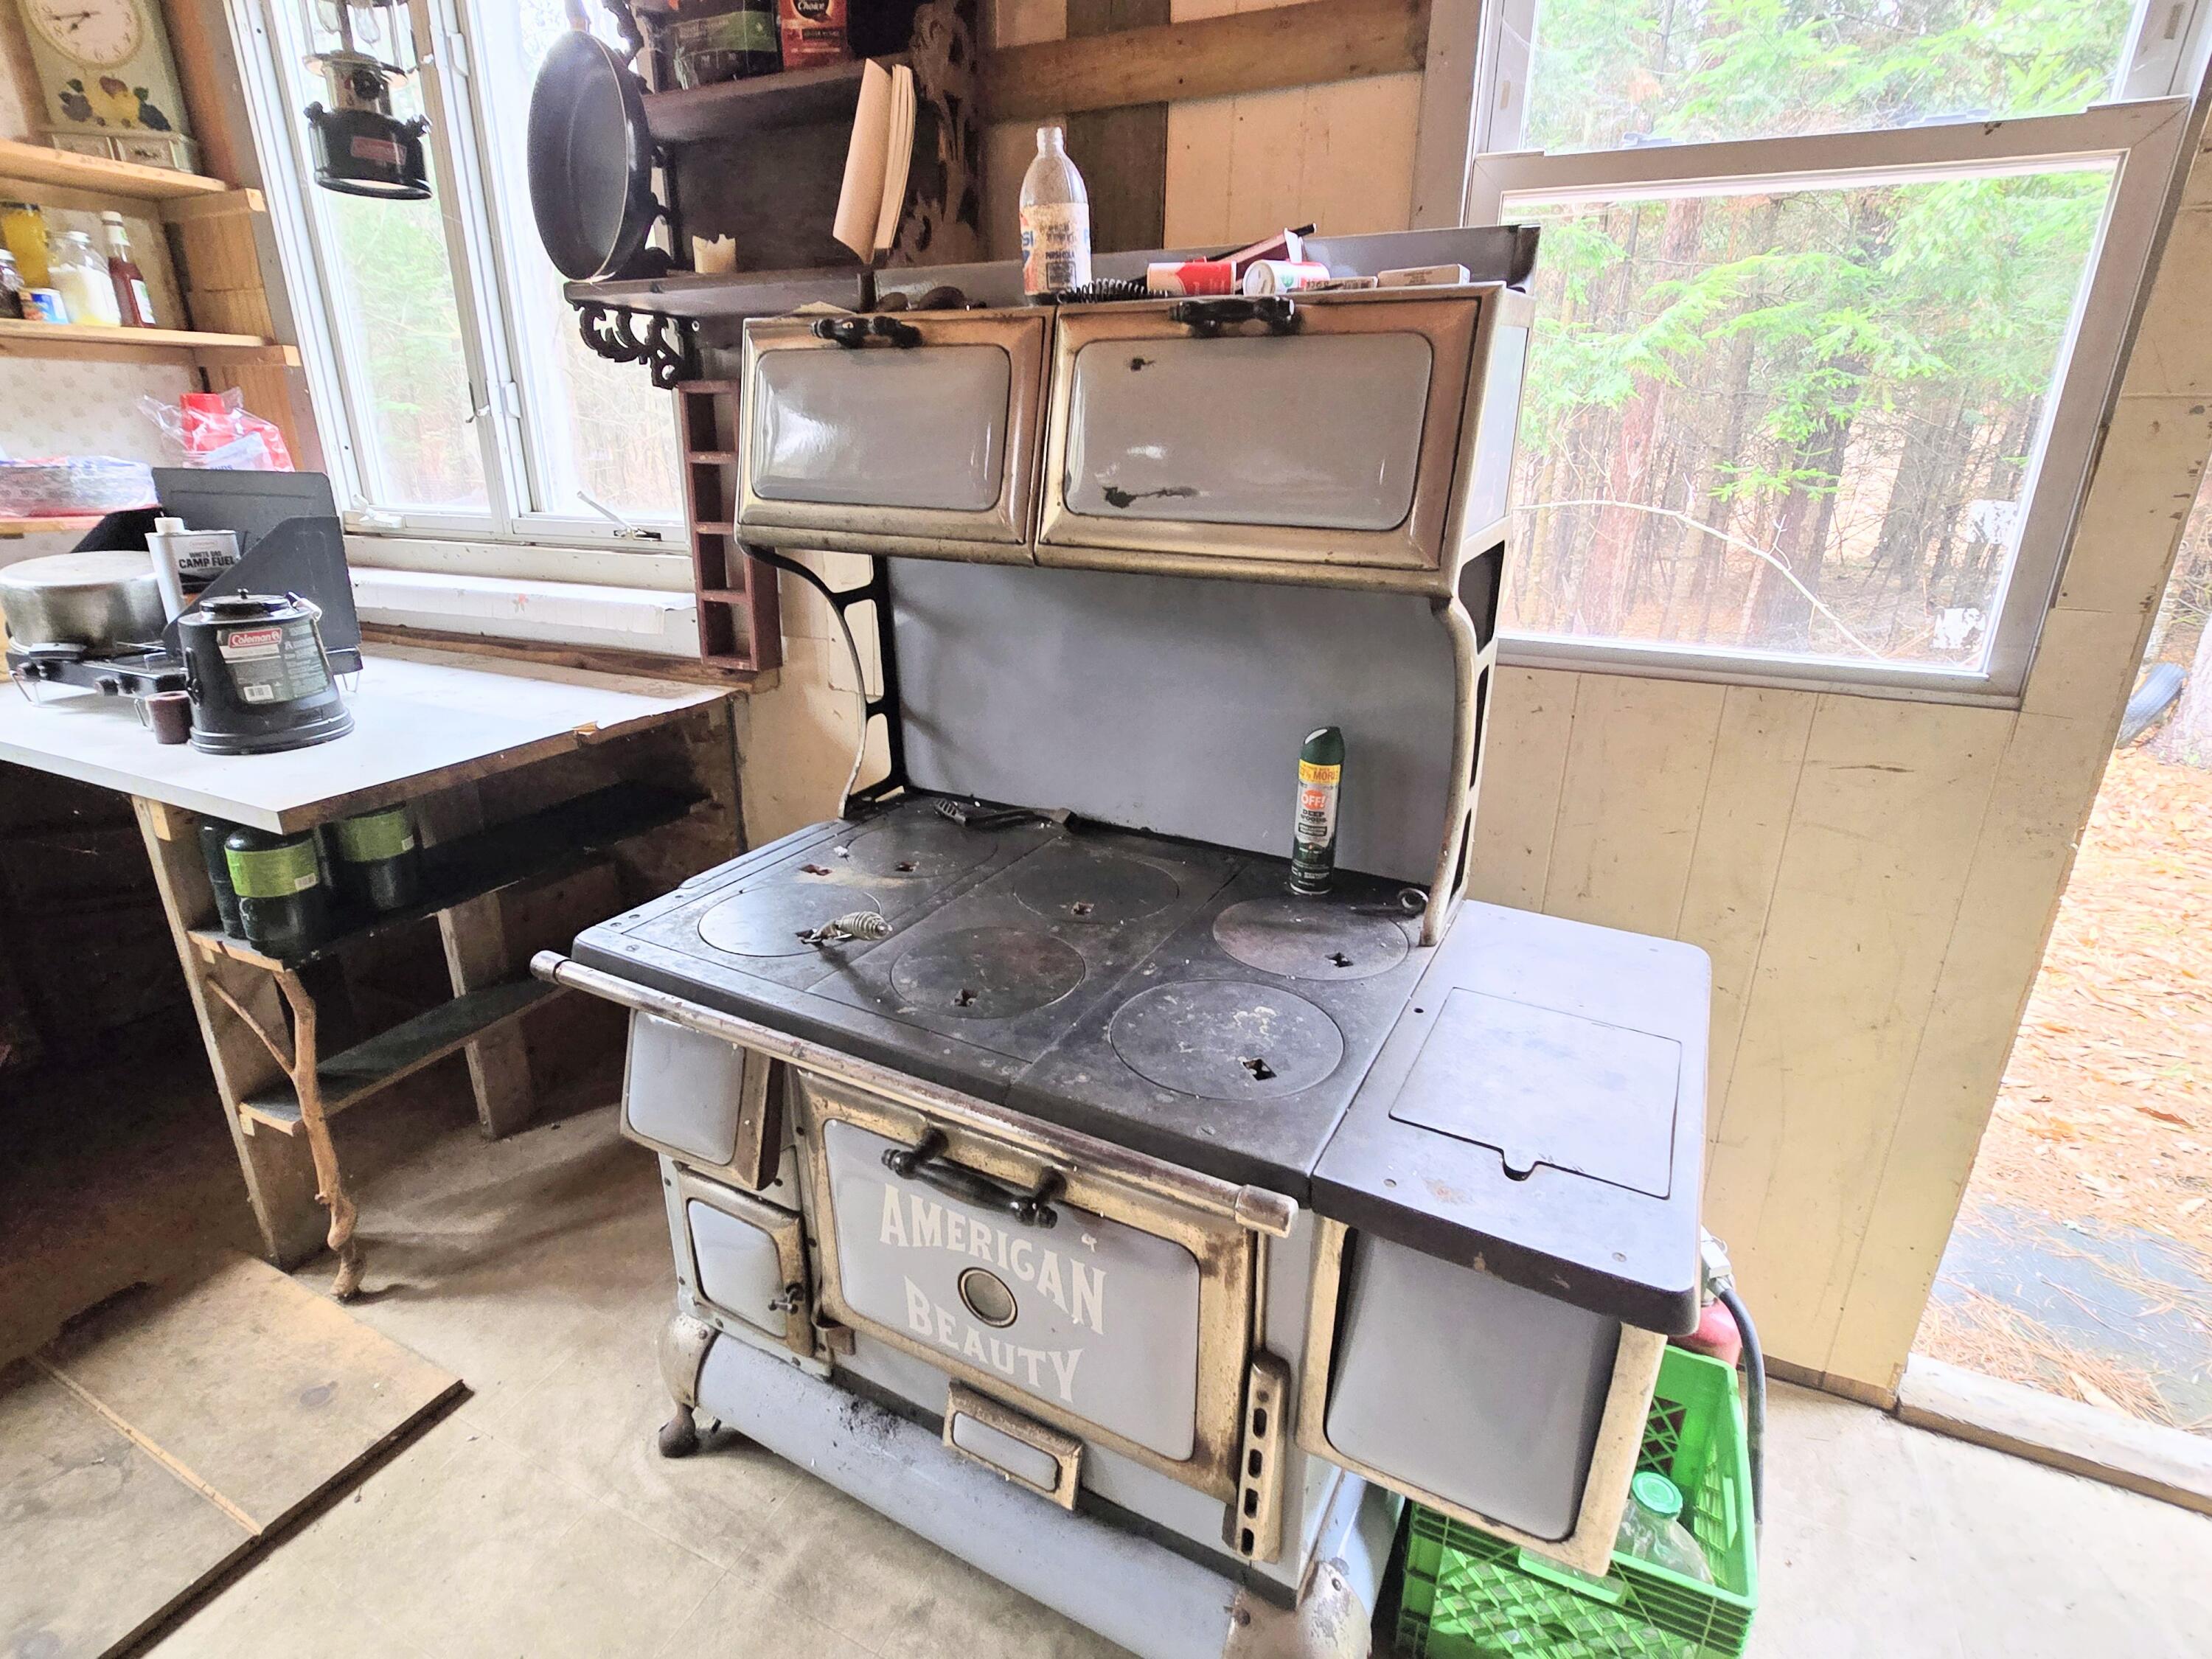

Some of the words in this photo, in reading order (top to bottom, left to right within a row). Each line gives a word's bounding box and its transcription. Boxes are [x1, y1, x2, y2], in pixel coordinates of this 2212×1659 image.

[797, 1, 825, 11] Choice
[179, 558, 210, 568] CAMP
[212, 555, 234, 566] FUEL
[232, 633, 271, 646] Coleman
[1301, 793, 1326, 807] OFF!
[879, 1183, 1107, 1335] AMERICAN
[904, 1274, 1085, 1404] BEAUTY
